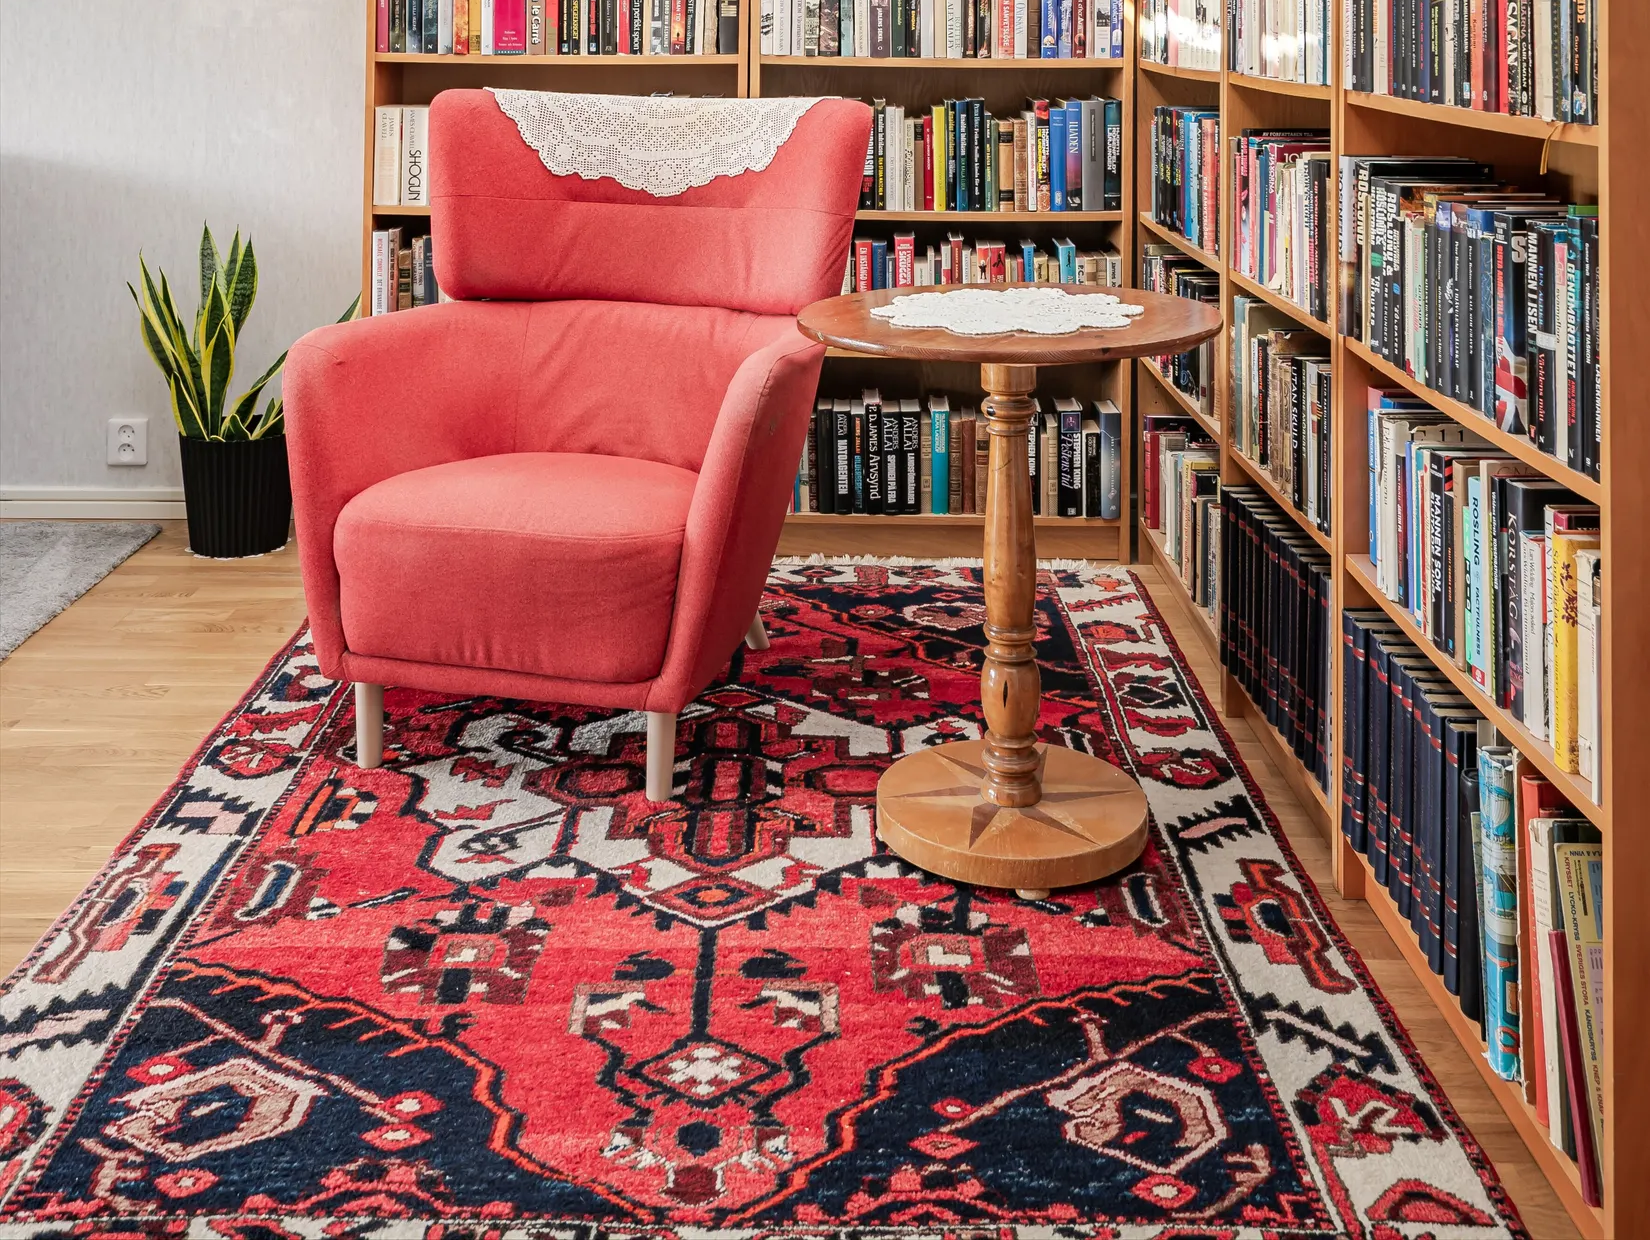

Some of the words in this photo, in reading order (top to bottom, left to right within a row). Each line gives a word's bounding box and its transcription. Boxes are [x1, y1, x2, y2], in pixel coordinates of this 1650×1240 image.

[532, 5, 541, 15] le
[531, 16, 541, 45] Carré
[632, 31, 642, 50] spion
[954, 16, 962, 49] RÖTTER
[1507, 4, 1518, 68] SAGAN
[408, 109, 416, 127] JAMES
[1069, 121, 1079, 154] ILIADEN
[408, 149, 422, 201] SHOGUN
[1356, 168, 1368, 246] ROSLUND
[1386, 192, 1397, 264] ROSLUND
[859, 247, 868, 255] EN
[898, 250, 907, 285] SKUGGA
[1527, 231, 1538, 291] MANNEN
[1527, 301, 1538, 334] ISEN
[1567, 262, 1577, 378] GENOMBROTTET
[1291, 366, 1299, 403] UTAN
[1538, 353, 1546, 396] Världens
[868, 405, 877, 413] P.
[868, 413, 877, 423] D.
[1538, 398, 1546, 422] mått
[868, 423, 878, 451] JAMES
[883, 417, 893, 451] JALLAI
[903, 416, 913, 451] JALLAI
[1291, 407, 1299, 450] SKULD
[838, 439, 848, 495] NATOAGENTEN
[1028, 457, 1036, 476] KING
[1060, 434, 1074, 471] Pestens
[1073, 433, 1081, 467] STEPHEN
[866, 453, 881, 500] Arvsynd
[887, 454, 896, 481] SPIONEN
[1061, 472, 1073, 490] tid
[1073, 468, 1081, 490] KING
[887, 490, 896, 504] FRA
[1433, 494, 1442, 558] MANNEN
[1472, 496, 1481, 566] ROSLING
[1434, 560, 1442, 593] SOM
[1474, 586, 1482, 656] FACTFULNESS
[1563, 857, 1573, 888] KRYSSET
[1568, 891, 1580, 941] LYCKO-KRYSS
[1575, 944, 1587, 979] SVERIGES
[1579, 980, 1590, 1006] STORA
[1584, 1009, 1598, 1061] KÄNDISKRYSS
[1592, 1063, 1601, 1085] KNEP
